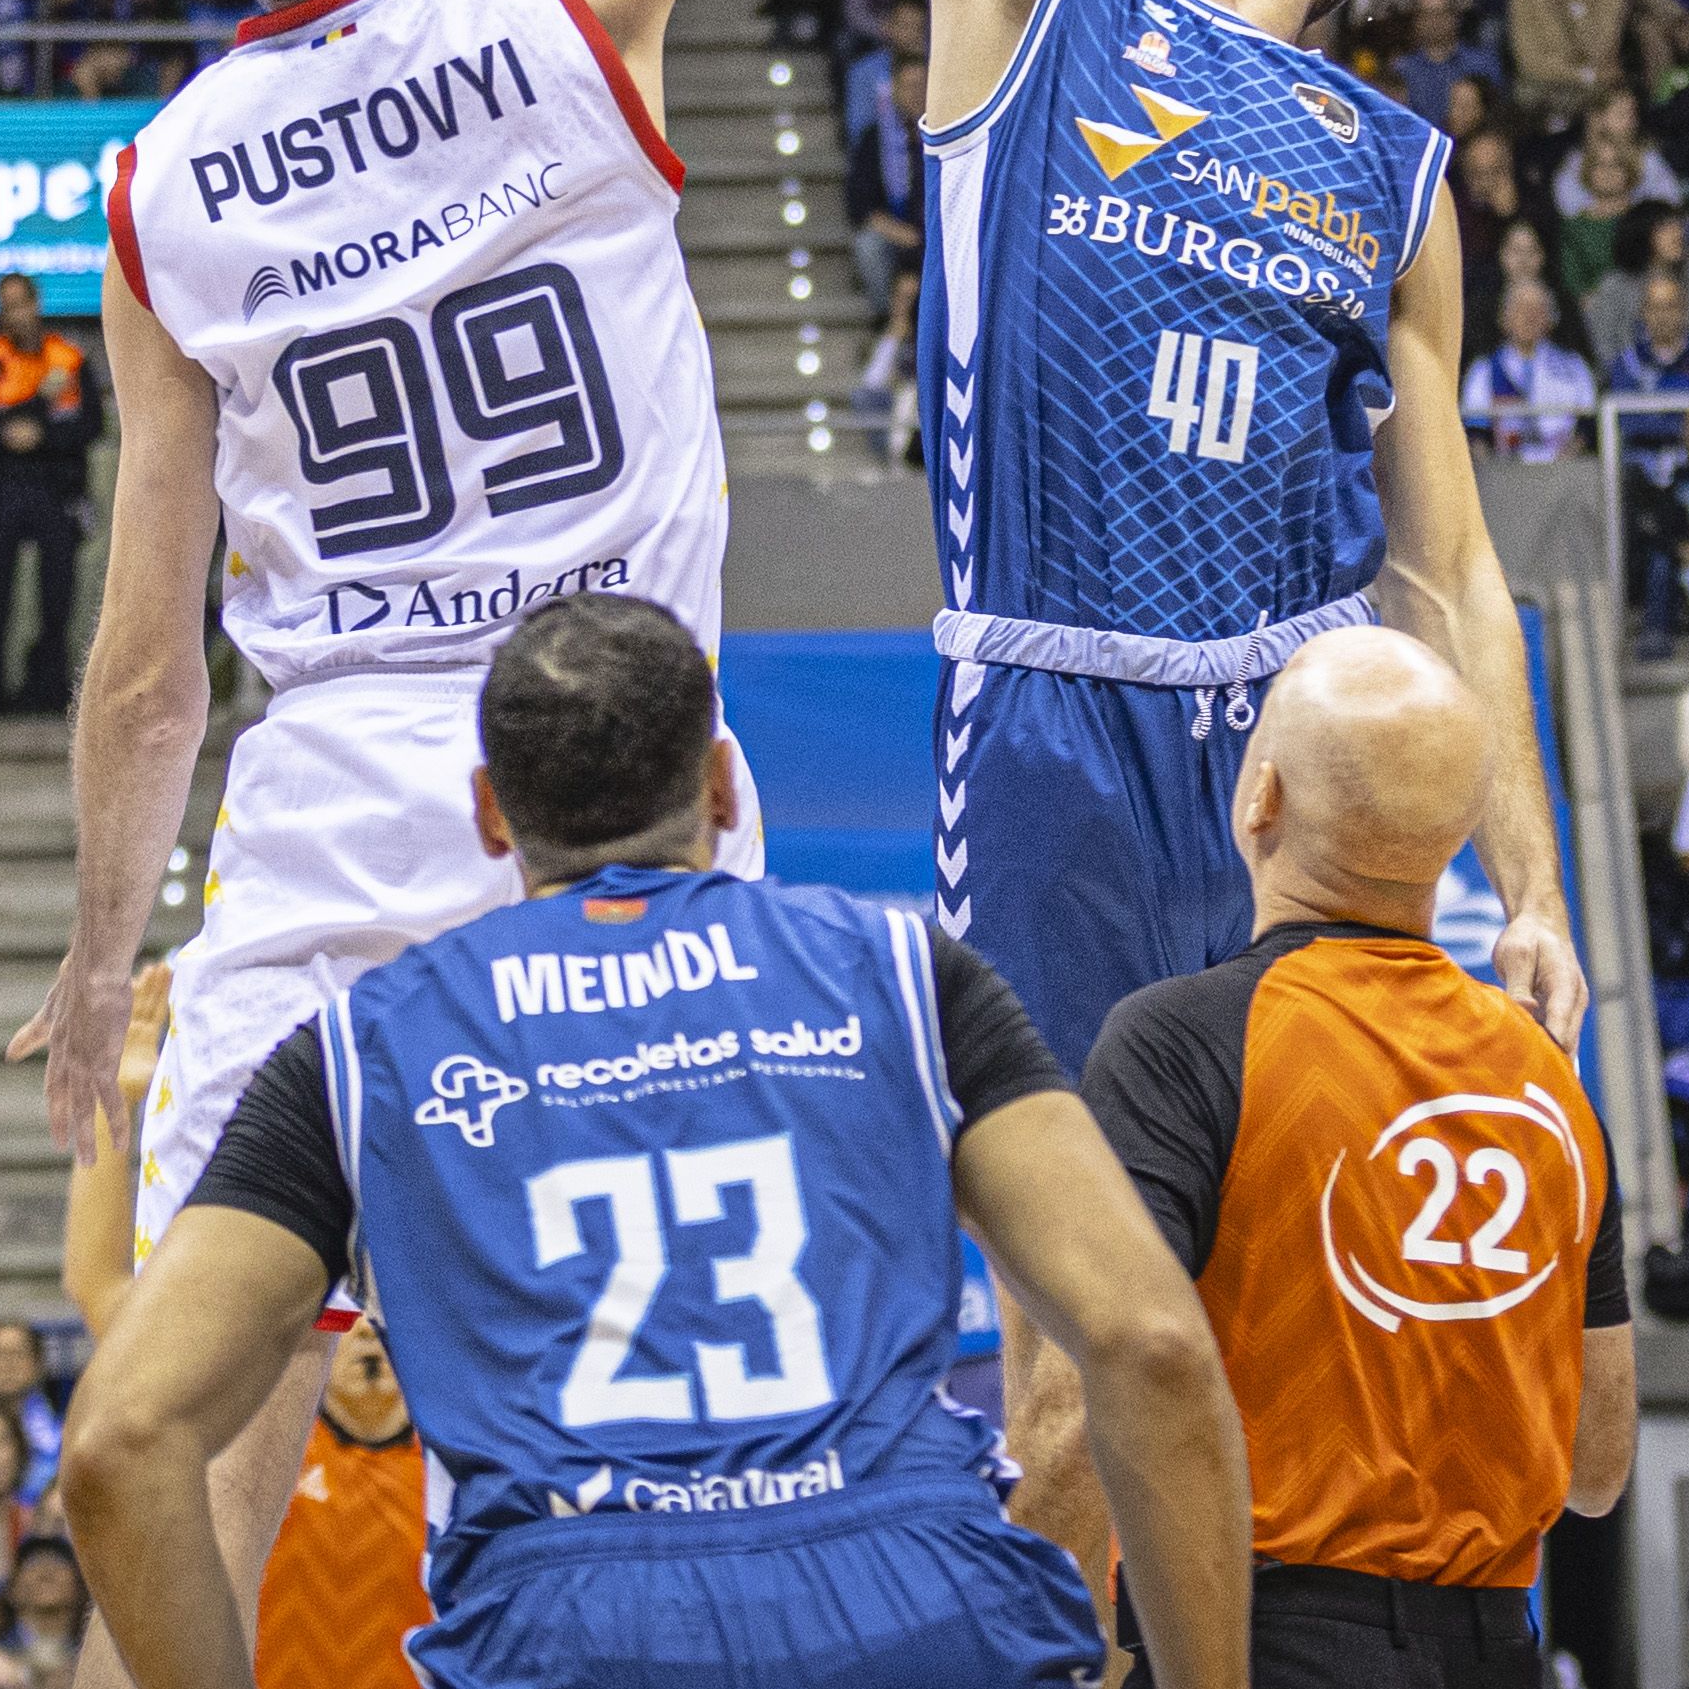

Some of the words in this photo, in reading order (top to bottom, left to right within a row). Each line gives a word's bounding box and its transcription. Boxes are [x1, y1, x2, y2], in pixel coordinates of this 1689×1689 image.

[189, 38, 538, 223] PUSTOVYI
[271, 261, 625, 560] 99
[1147, 330, 1259, 464] 40
[490, 923, 758, 1023] MEINDL
[536, 1029, 741, 1089] recoletas
[750, 1015, 861, 1058] salud
[1397, 1136, 1530, 1275] 22
[525, 1131, 839, 1428] 23
